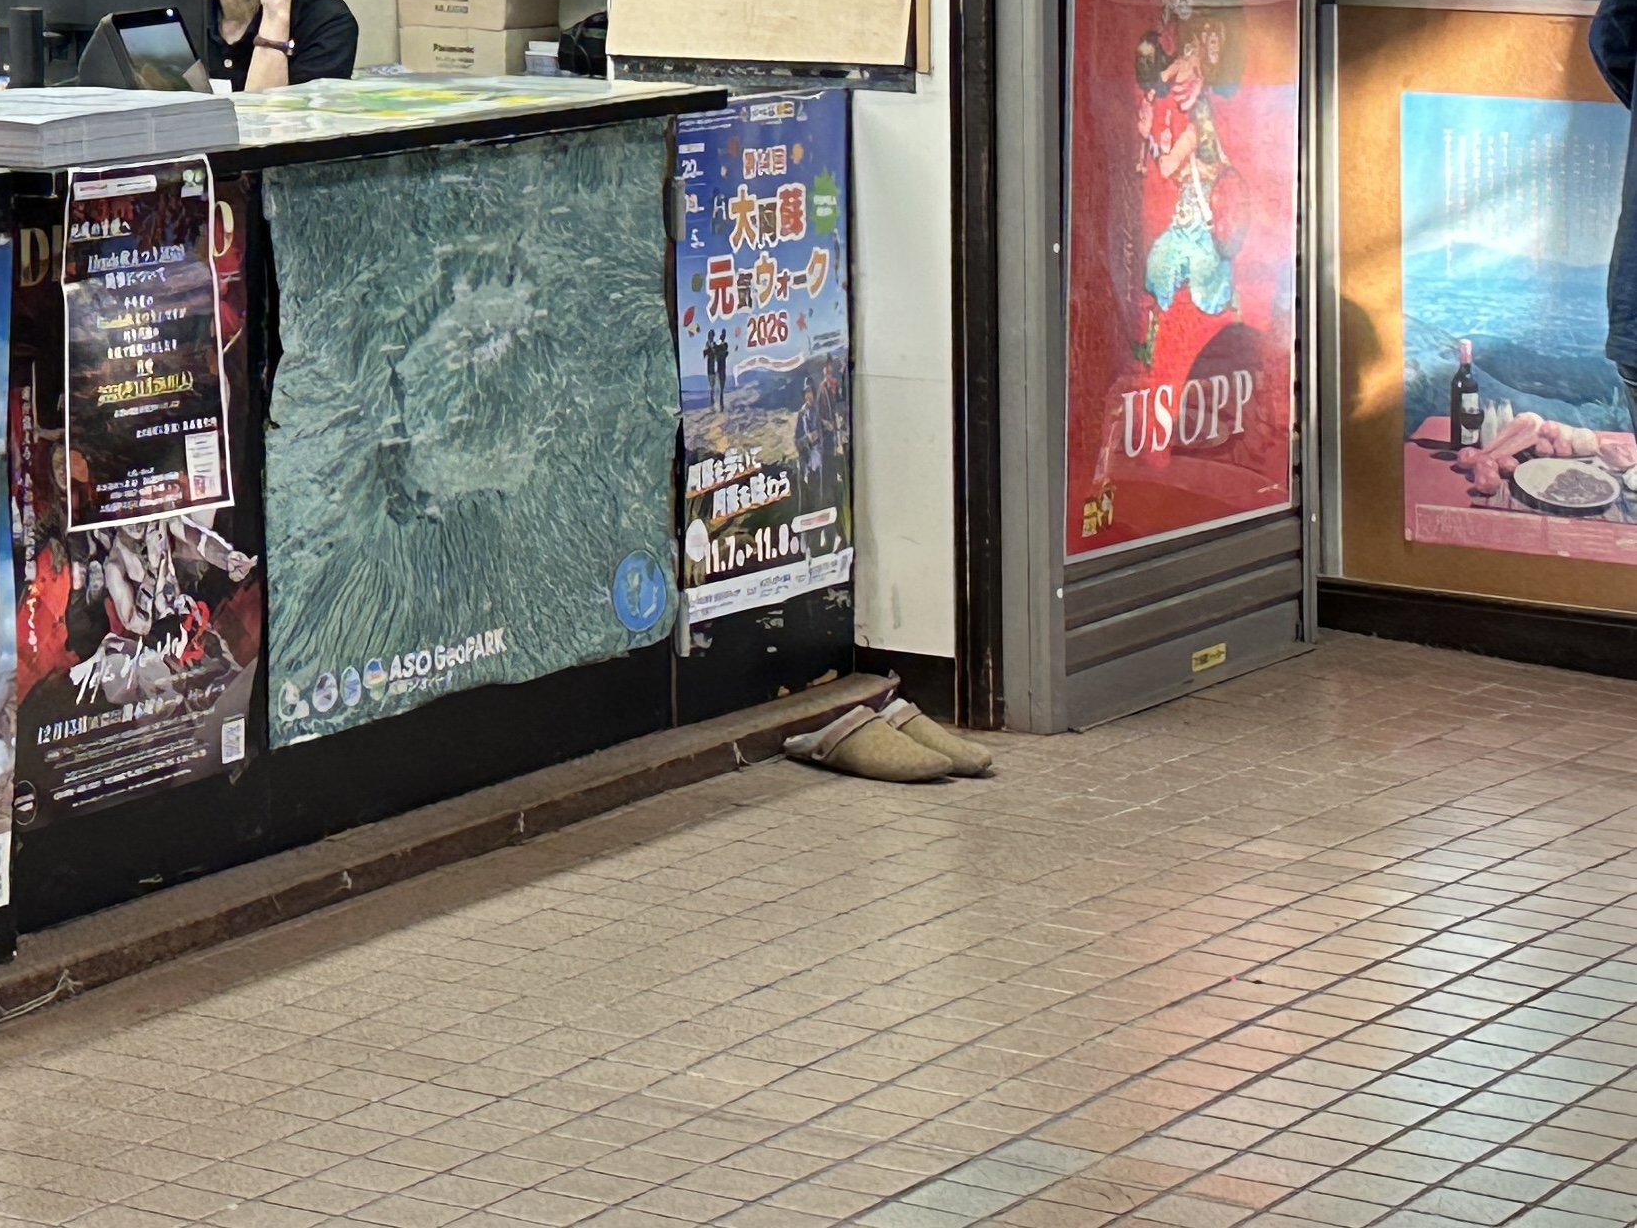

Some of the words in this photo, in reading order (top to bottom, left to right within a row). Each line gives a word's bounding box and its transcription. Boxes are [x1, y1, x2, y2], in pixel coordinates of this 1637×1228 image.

[729, 183, 806, 253] 大阿蘇
[707, 247, 830, 321] 元気ウォーク
[747, 312, 788, 348] 2026
[1122, 370, 1253, 458] USOPP
[388, 651, 432, 681] ASO
